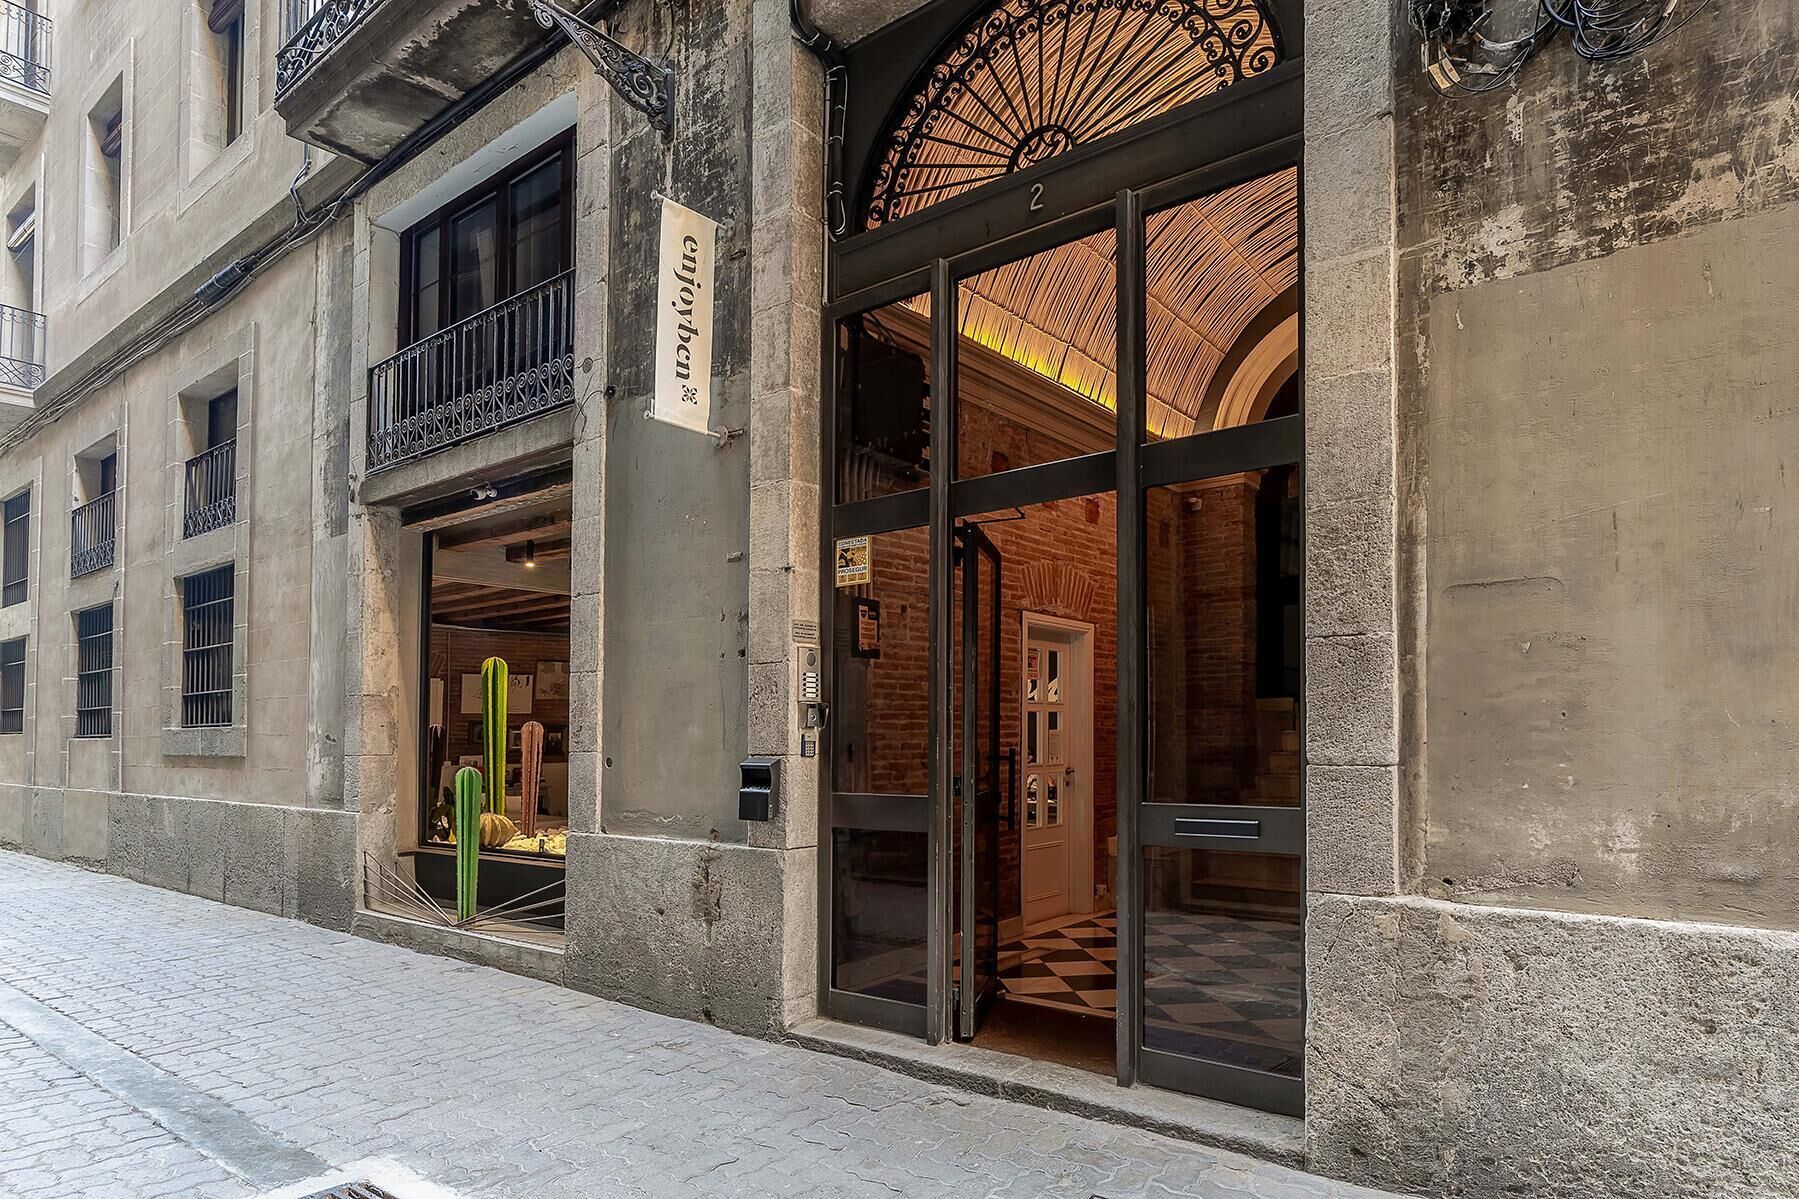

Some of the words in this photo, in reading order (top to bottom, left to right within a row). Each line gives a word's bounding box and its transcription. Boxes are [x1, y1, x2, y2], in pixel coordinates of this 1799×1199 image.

[1030, 183, 1044, 211] 2
[671, 235, 701, 381] enjoybcn
[838, 566, 867, 574] PROSEGUR
